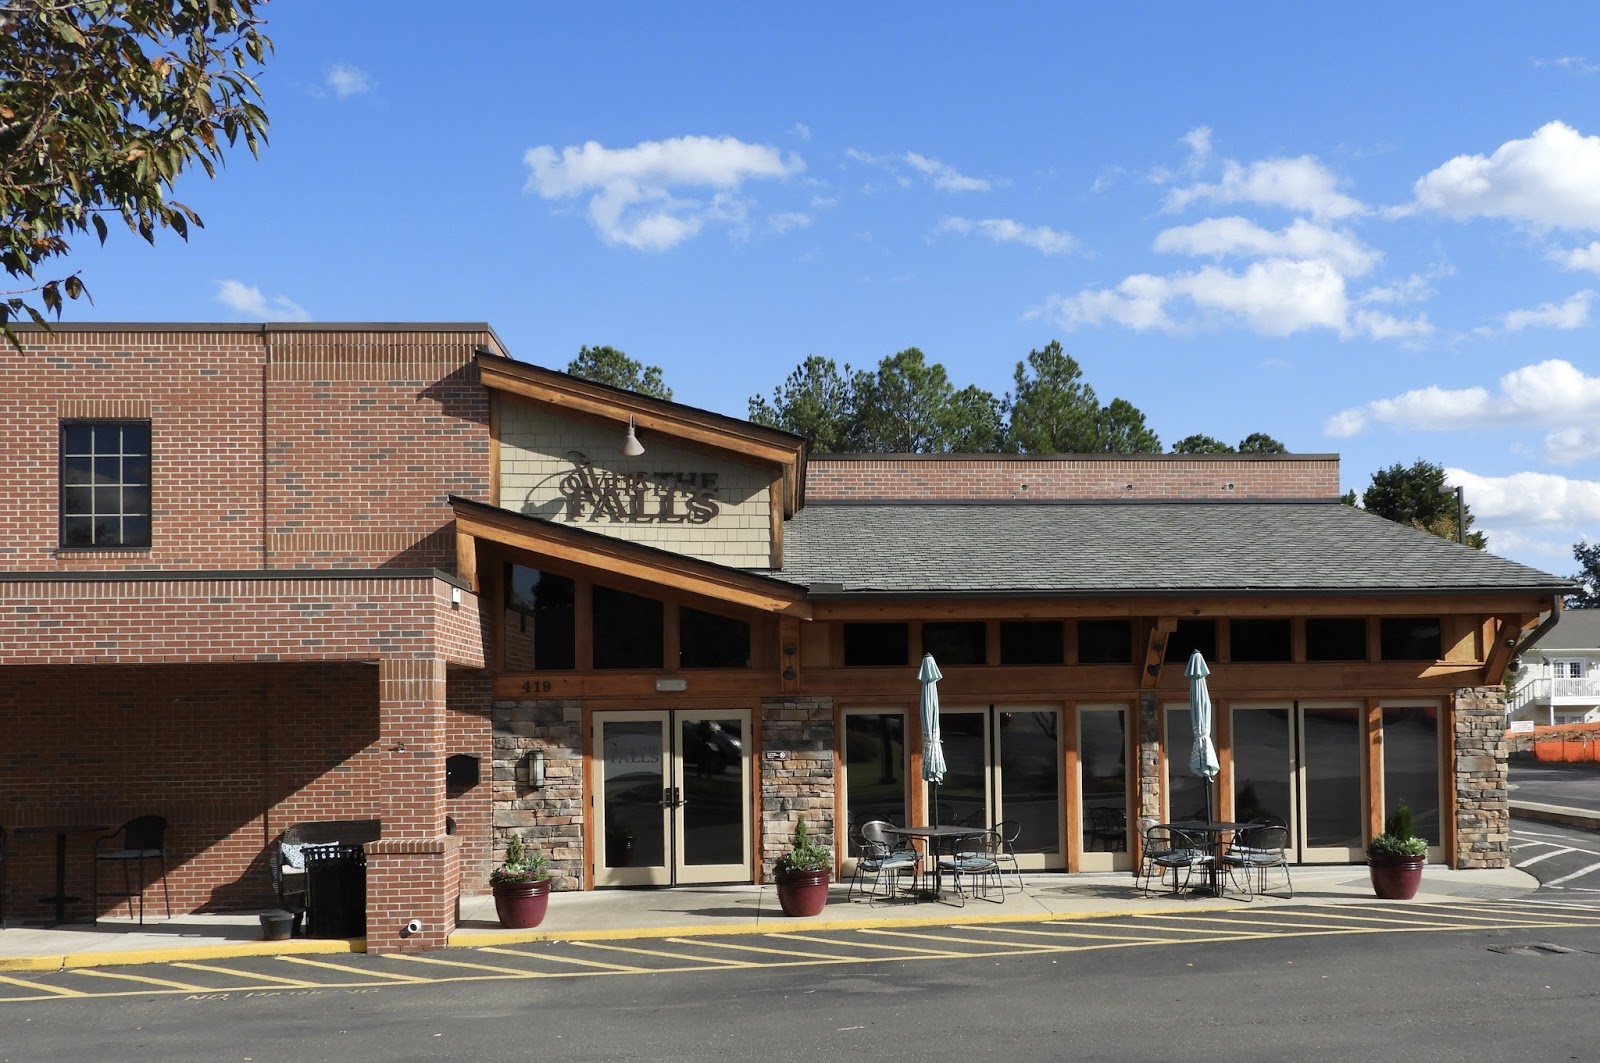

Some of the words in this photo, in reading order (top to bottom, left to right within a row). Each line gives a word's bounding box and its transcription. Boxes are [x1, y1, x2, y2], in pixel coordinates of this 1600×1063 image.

[652, 470, 719, 492] THE
[571, 488, 721, 522] FALLS
[521, 680, 552, 693] 419
